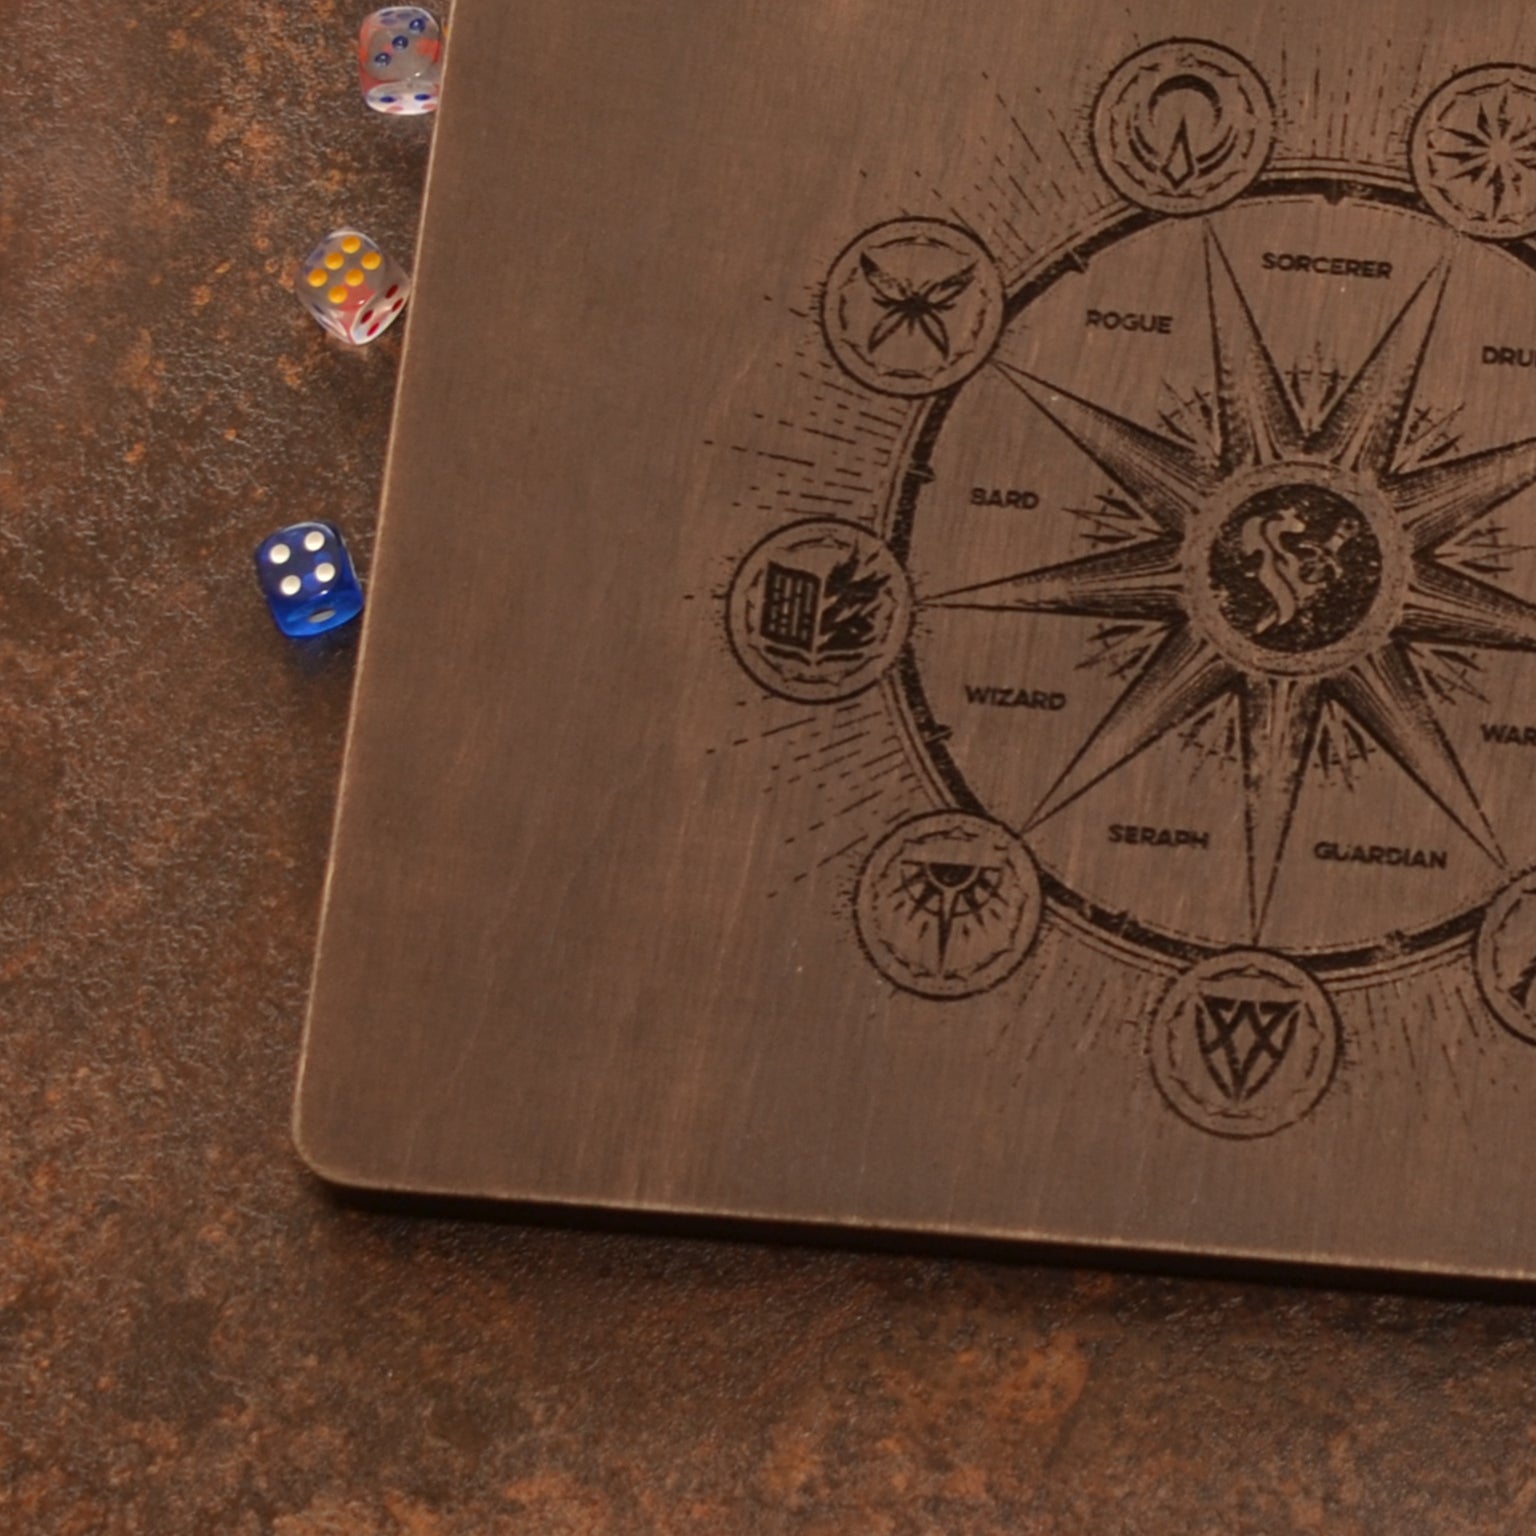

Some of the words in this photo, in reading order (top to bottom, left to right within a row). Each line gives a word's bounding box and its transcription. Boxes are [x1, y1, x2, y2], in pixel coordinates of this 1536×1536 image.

[1260, 252, 1394, 280] SORCERER
[1085, 310, 1173, 334] ROGUE
[965, 686, 1066, 711] WIZARD
